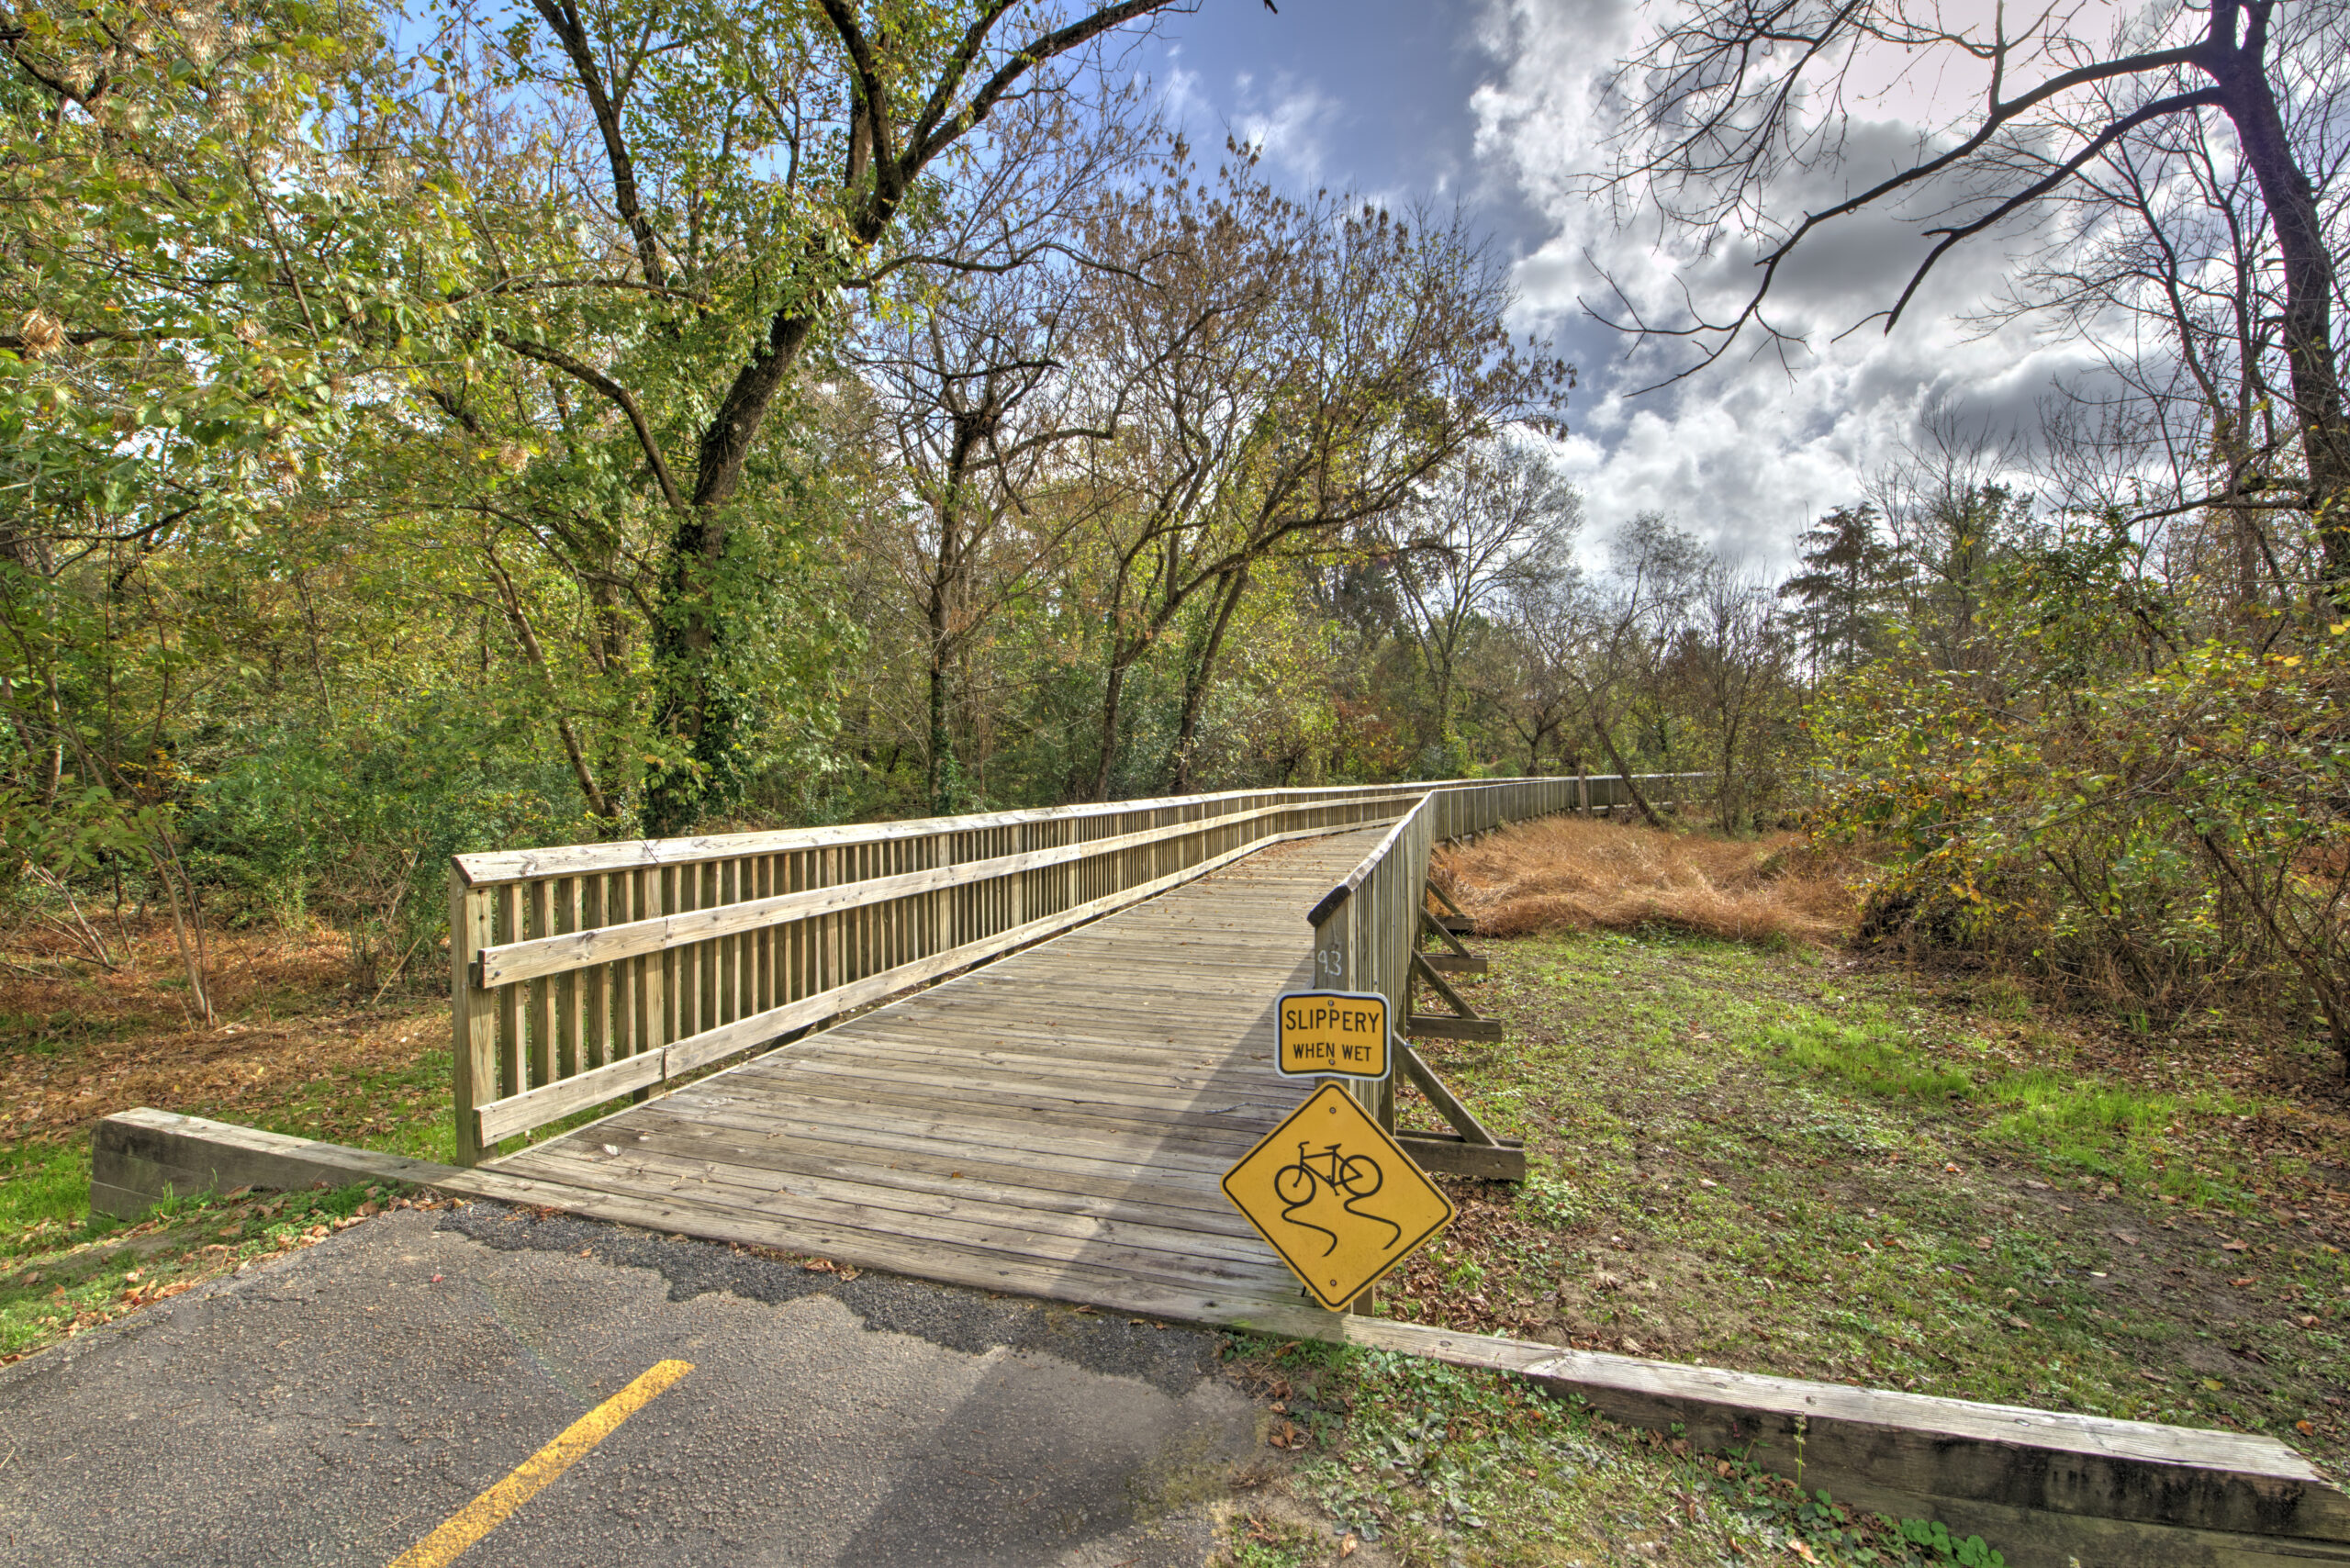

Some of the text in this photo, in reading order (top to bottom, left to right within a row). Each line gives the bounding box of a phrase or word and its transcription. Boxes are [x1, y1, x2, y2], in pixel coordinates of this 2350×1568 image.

[1317, 949, 1342, 977] 93
[1285, 1008, 1380, 1034] SLIPPERY
[1292, 1042, 1372, 1062] WHEN WET
